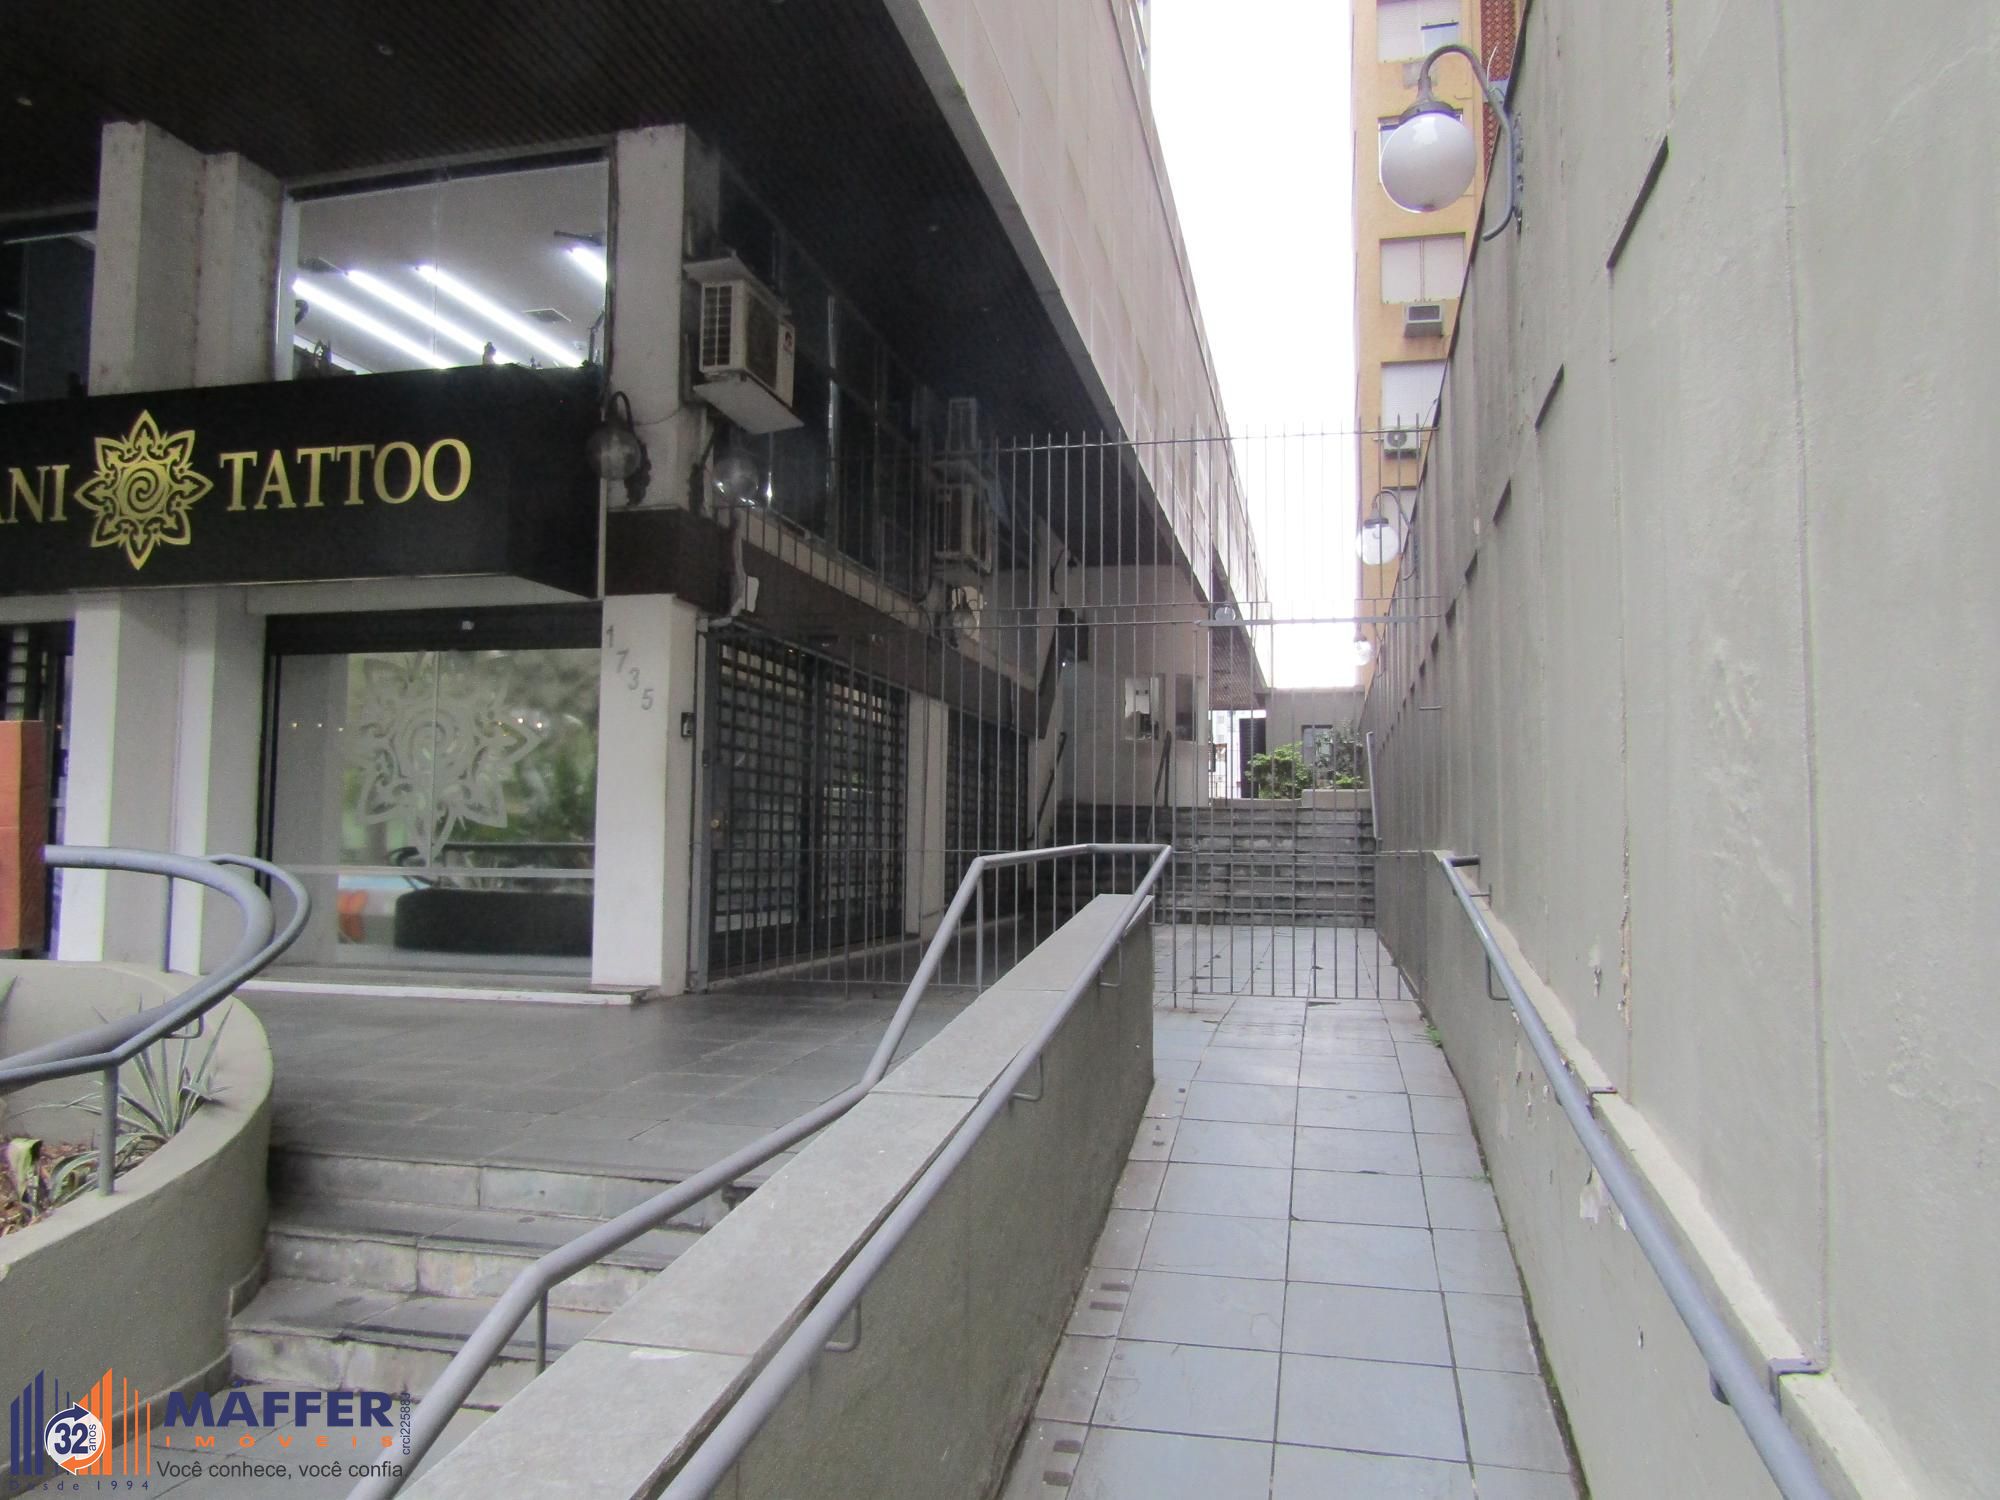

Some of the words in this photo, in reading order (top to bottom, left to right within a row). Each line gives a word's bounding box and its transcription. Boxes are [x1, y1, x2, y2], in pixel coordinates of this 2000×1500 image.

[0, 464, 70, 524] NI
[219, 438, 472, 511] TATTOO
[606, 625, 654, 711] 1735
